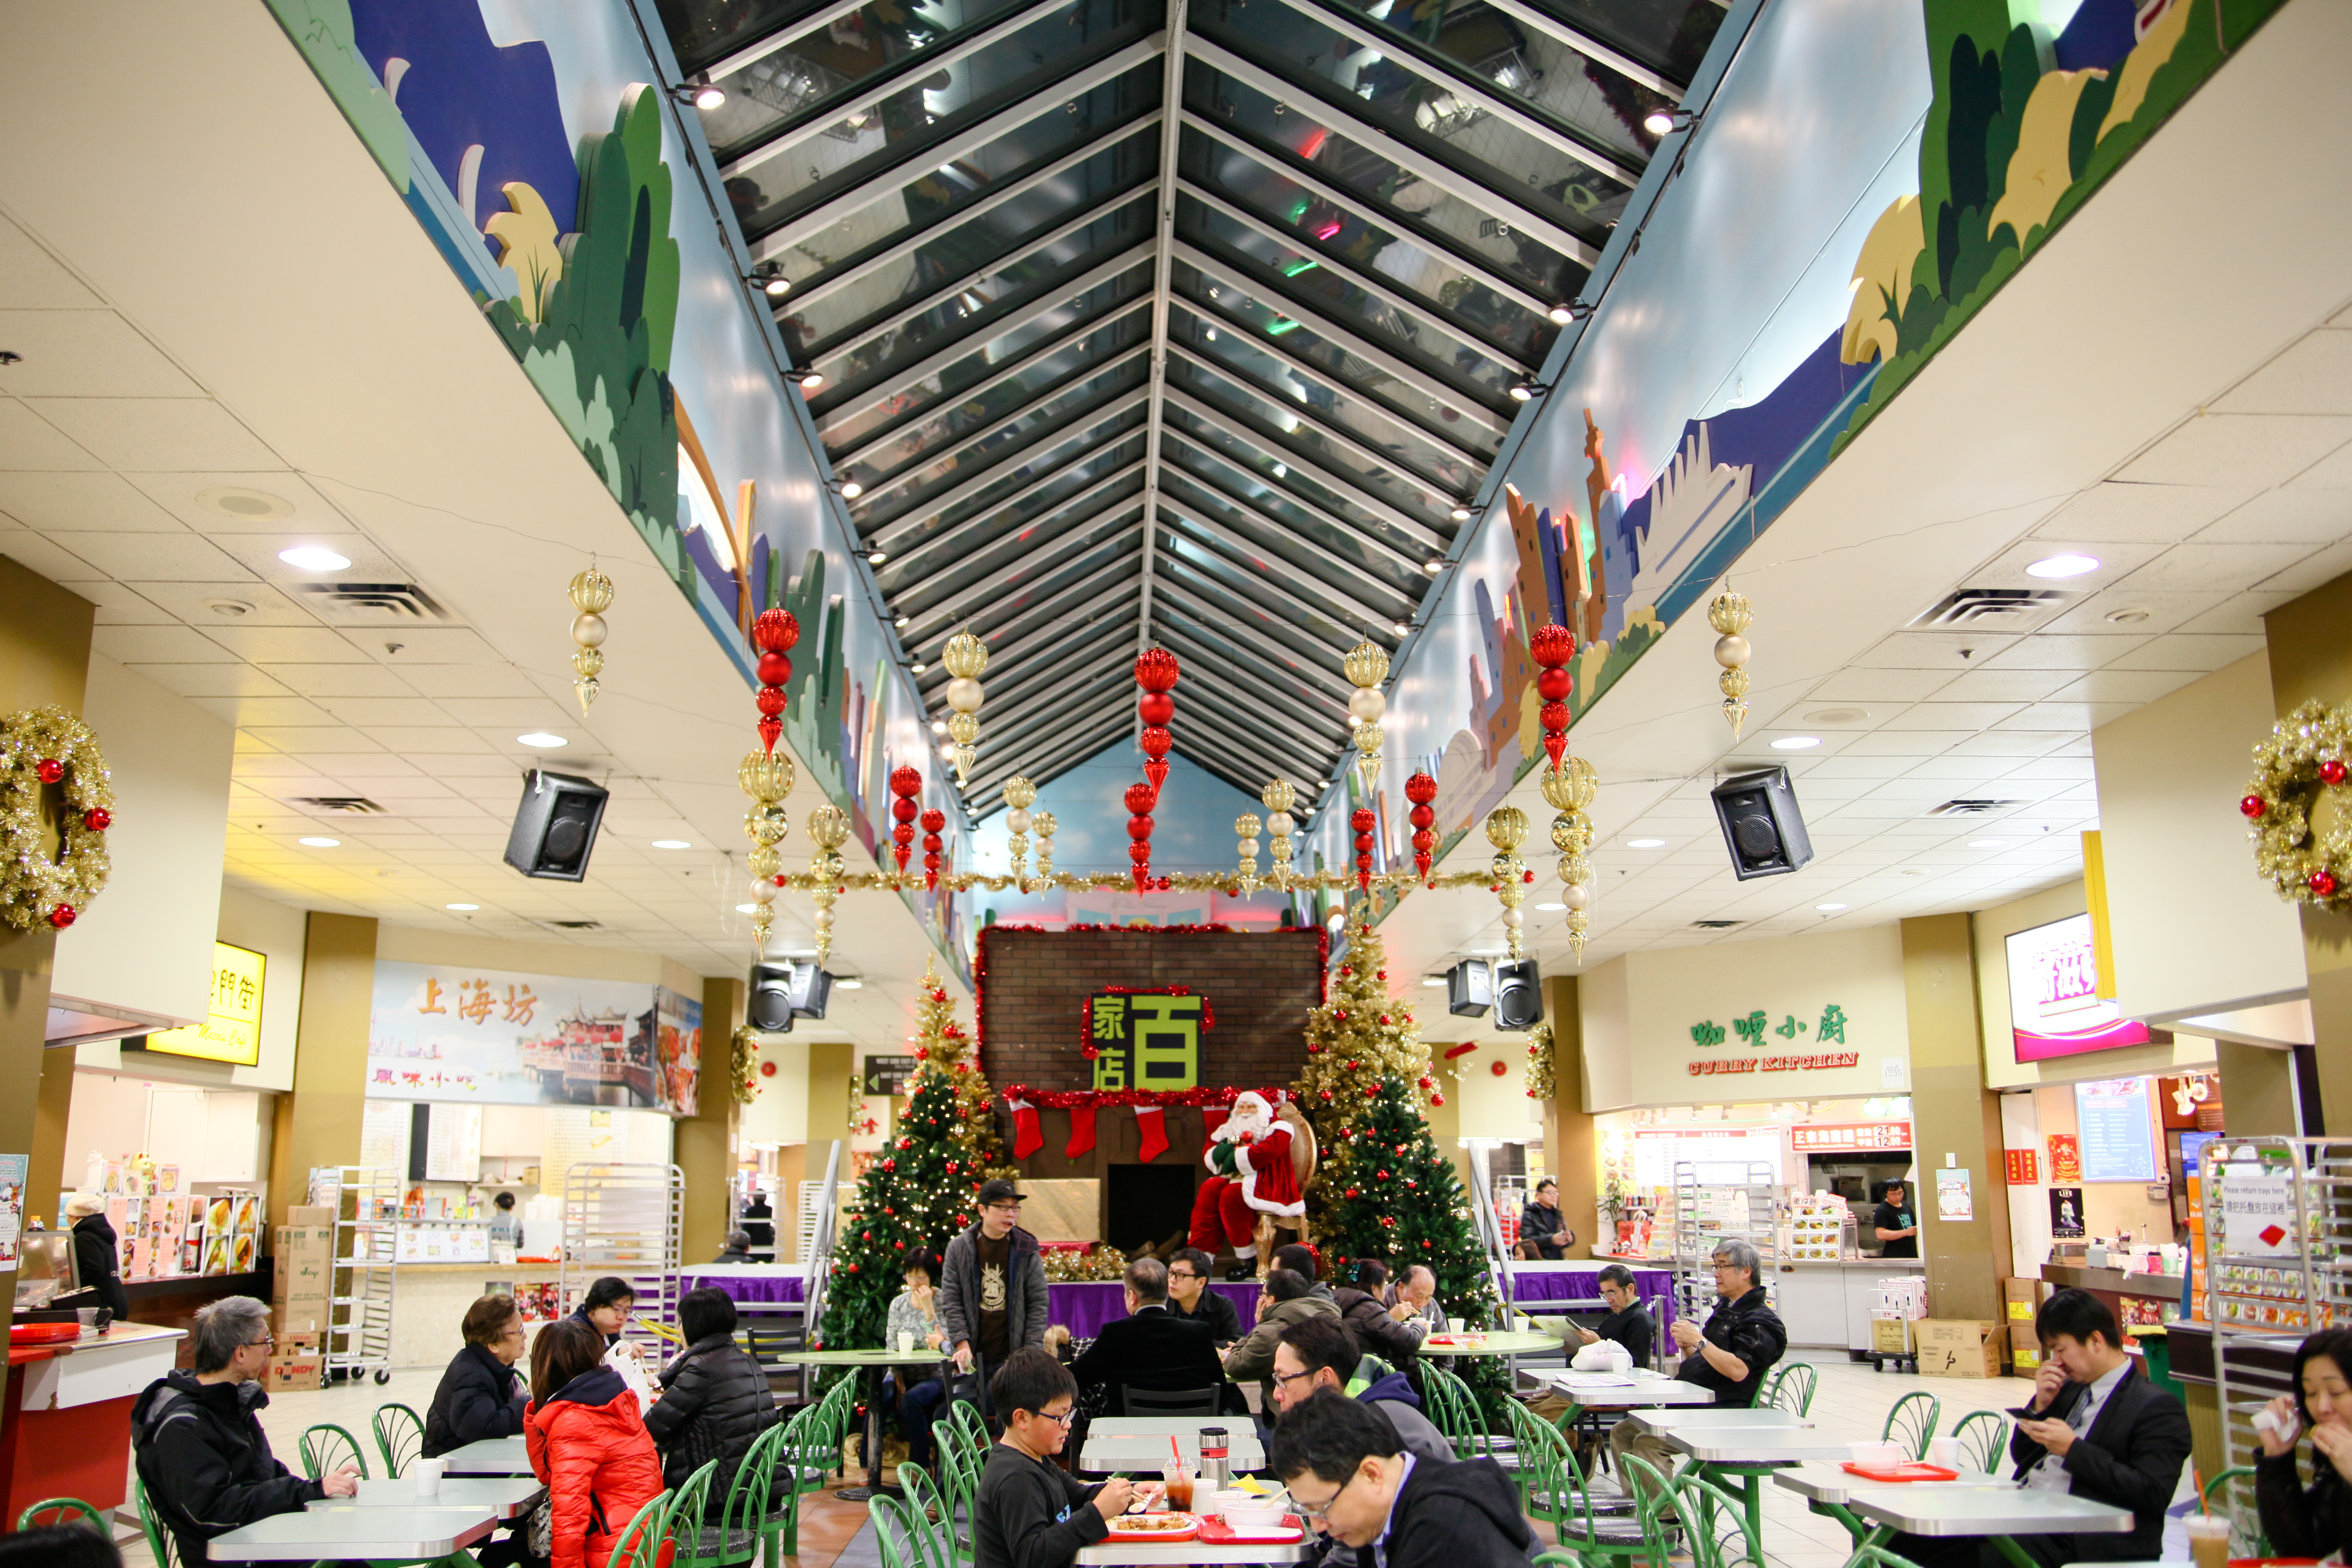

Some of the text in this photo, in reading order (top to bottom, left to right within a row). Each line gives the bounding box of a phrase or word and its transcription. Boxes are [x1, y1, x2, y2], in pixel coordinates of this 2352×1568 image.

[210, 969, 255, 1011] 門街
[418, 978, 537, 1026] 上海坊
[198, 1024, 247, 1050] Macau Cafe
[1691, 1004, 1848, 1046] 咖喱小廚
[1131, 995, 1201, 1092] 百
[1689, 1051, 1859, 1076] CURRY KITCHEN
[371, 1067, 477, 1091] 風味小吃
[1824, 1199, 1846, 1208] NOODLES
[2223, 1186, 2284, 1196] Please return trays here
